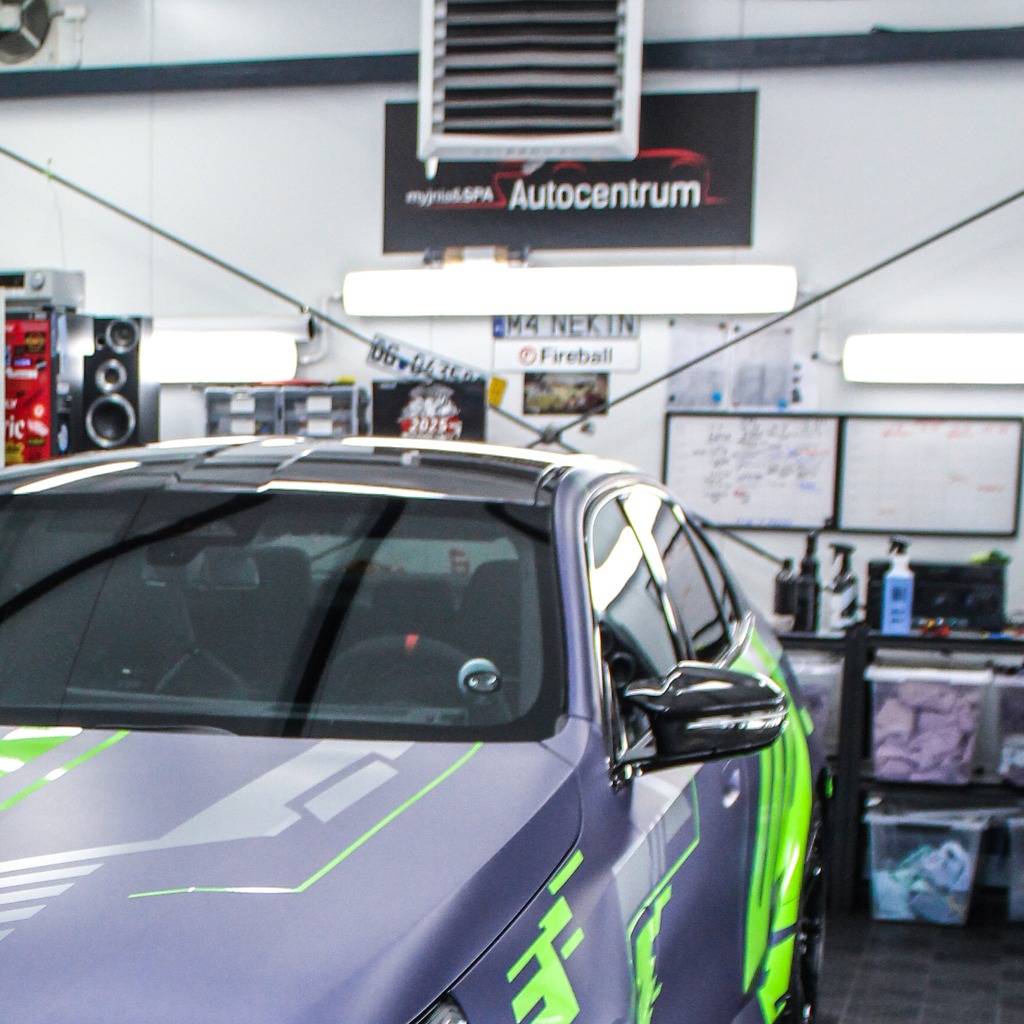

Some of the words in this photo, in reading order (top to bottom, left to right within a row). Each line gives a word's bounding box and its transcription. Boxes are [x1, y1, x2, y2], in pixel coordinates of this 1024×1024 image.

[507, 178, 701, 211] Autocentrum
[506, 315, 538, 333] M4
[540, 346, 613, 364] Fireball
